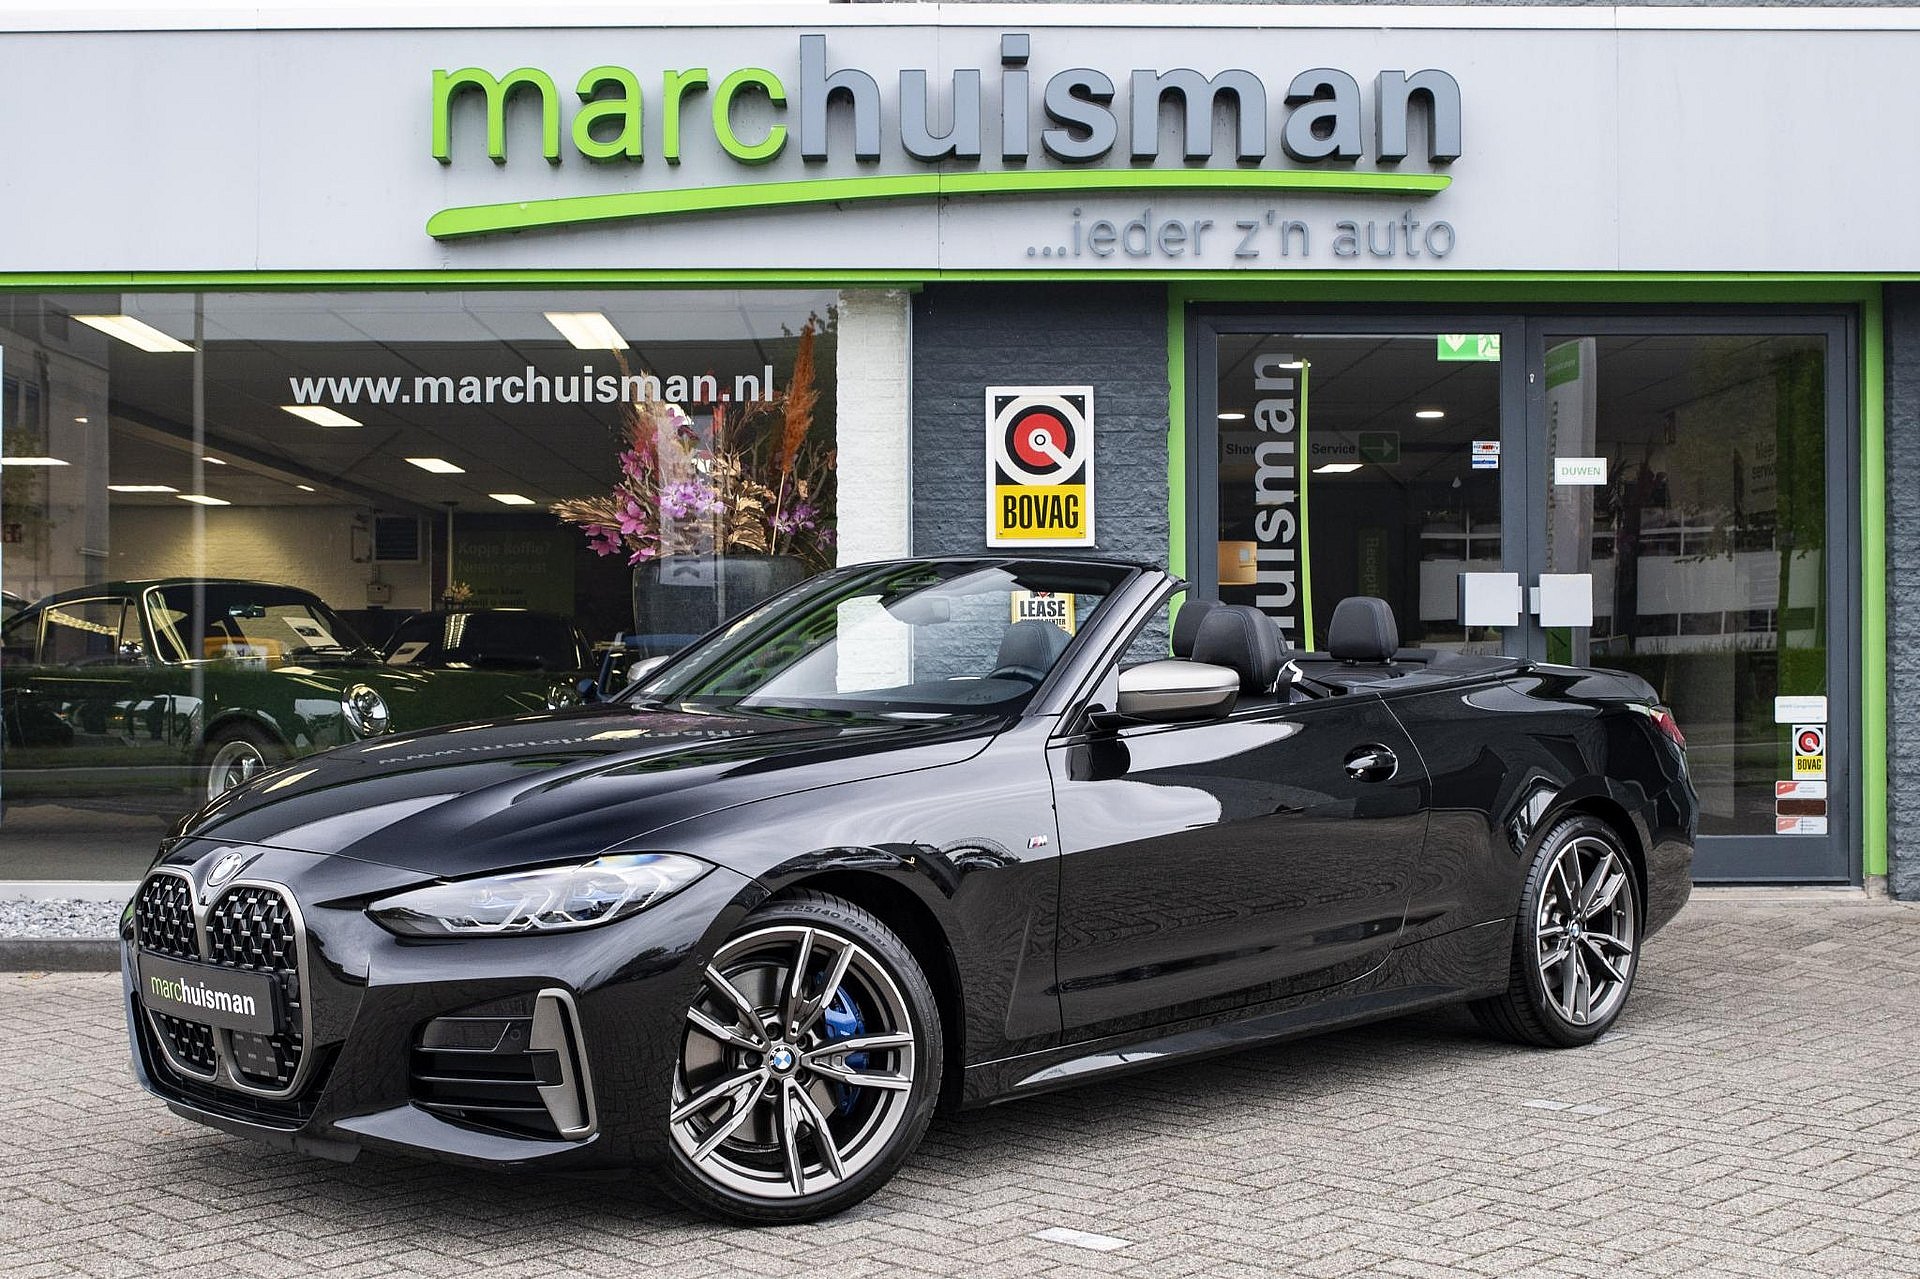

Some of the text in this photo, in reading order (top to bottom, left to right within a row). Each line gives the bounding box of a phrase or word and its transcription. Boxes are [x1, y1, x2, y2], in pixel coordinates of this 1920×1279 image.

[431, 33, 1462, 164] marchuisman
[1027, 208, 1456, 256] ...ieder z'n auto
[289, 365, 774, 404] www.marchuisman.nl
[1312, 443, 1357, 454] Service
[1561, 466, 1601, 475] DUWEN
[1003, 494, 1079, 529] BOVAG
[1020, 600, 1066, 617] LEASE
[1797, 758, 1822, 770] BOVAG
[150, 976, 256, 1016] marchuisman
